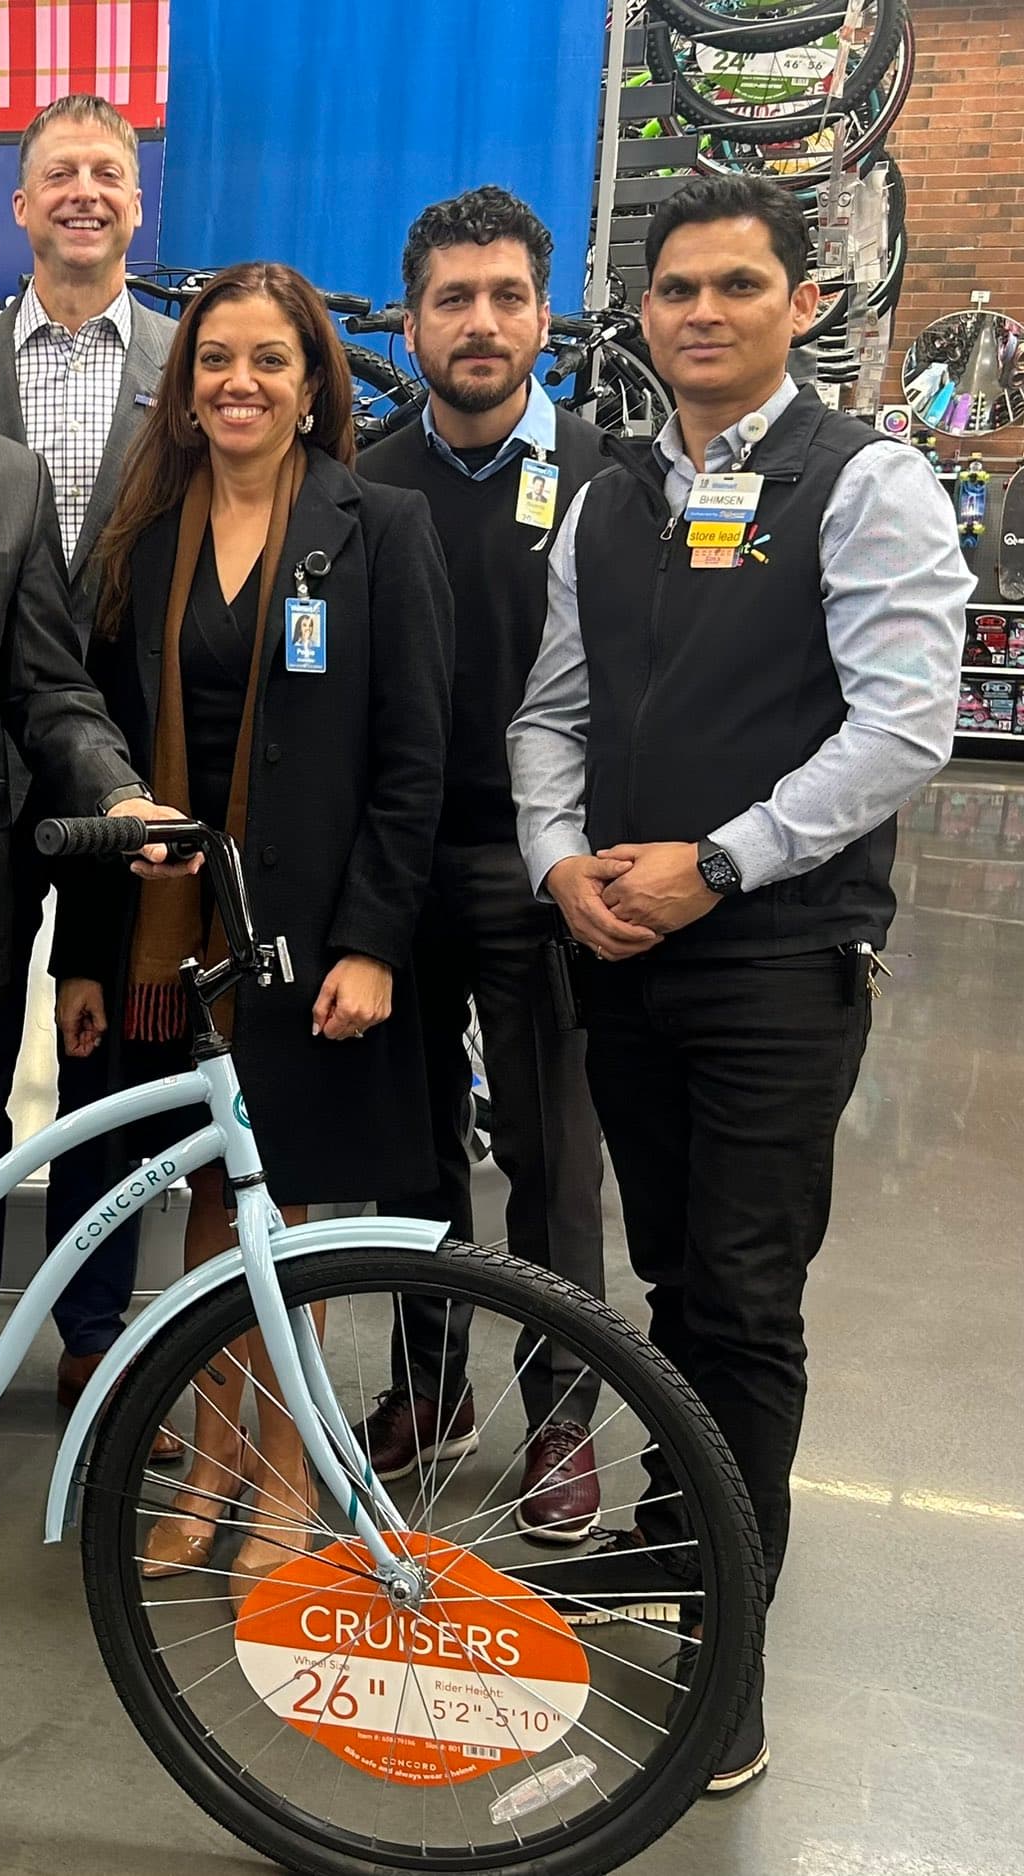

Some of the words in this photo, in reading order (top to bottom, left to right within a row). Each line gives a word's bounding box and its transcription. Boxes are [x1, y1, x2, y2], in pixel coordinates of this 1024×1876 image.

[699, 495, 744, 505] BHIMSEN
[689, 532, 716, 541] store
[719, 531, 741, 541] lead
[75, 1160, 176, 1251] CONCORD
[300, 1605, 520, 1666] CRUISERS
[293, 1655, 327, 1669] Wheel
[330, 1659, 351, 1672] Size
[435, 1680, 463, 1694] Rider
[465, 1684, 504, 1699] Height:
[344, 1745, 360, 1760] Bike
[361, 1756, 377, 1769] safe
[378, 1765, 393, 1775] and
[394, 1769, 422, 1780] always
[423, 1771, 443, 1780] wear
[450, 1764, 478, 1777] helmet
[381, 1757, 437, 1772] CONCORD
